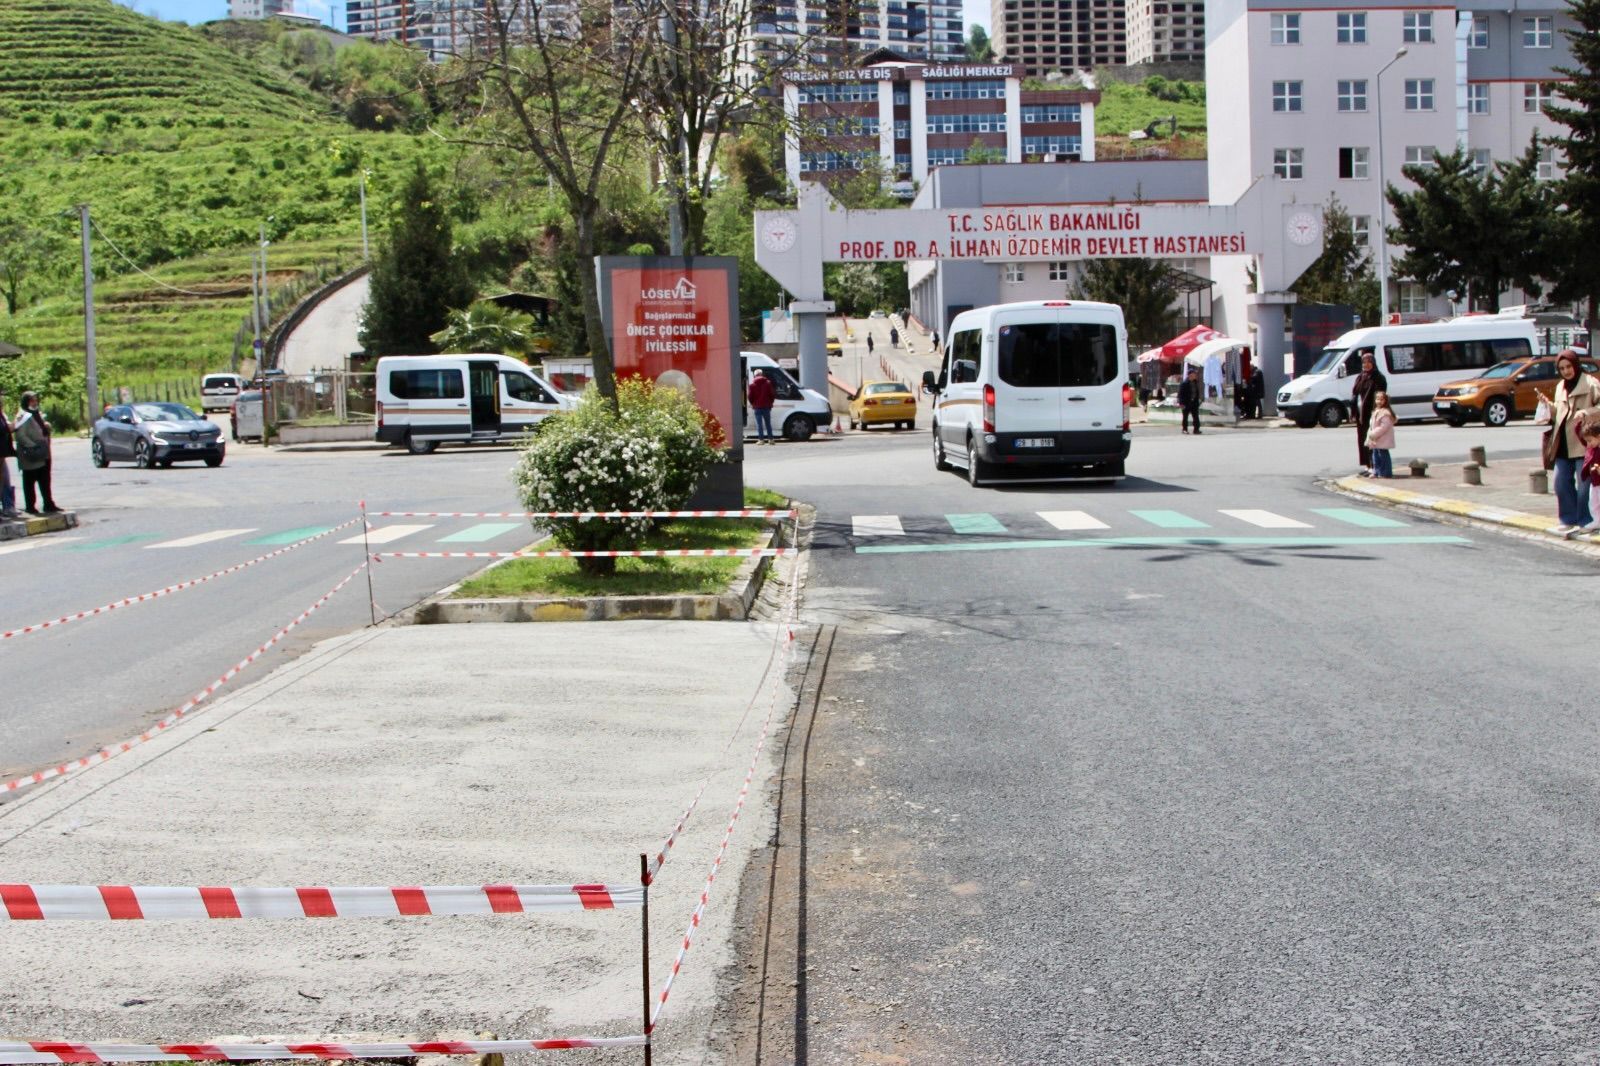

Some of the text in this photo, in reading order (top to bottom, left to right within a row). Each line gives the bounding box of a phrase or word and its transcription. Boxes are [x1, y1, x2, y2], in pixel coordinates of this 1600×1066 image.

[857, 69, 871, 79] VE
[873, 66, 891, 80] DİŞ
[922, 65, 963, 78] SAĞLIĞI
[966, 64, 1013, 77] MERKEZİ
[947, 208, 1140, 232] T.C. SAĞLIK BAKANLIĞI
[840, 231, 1246, 259] PROF. DR. A. İLHAN ÖZDEMİR DEVLET HASTANESİ
[642, 288, 680, 299] LÖSEV
[627, 322, 714, 338] ÖNCE ÇOCUKLAR
[646, 340, 697, 354] İYİLEŞSİN
